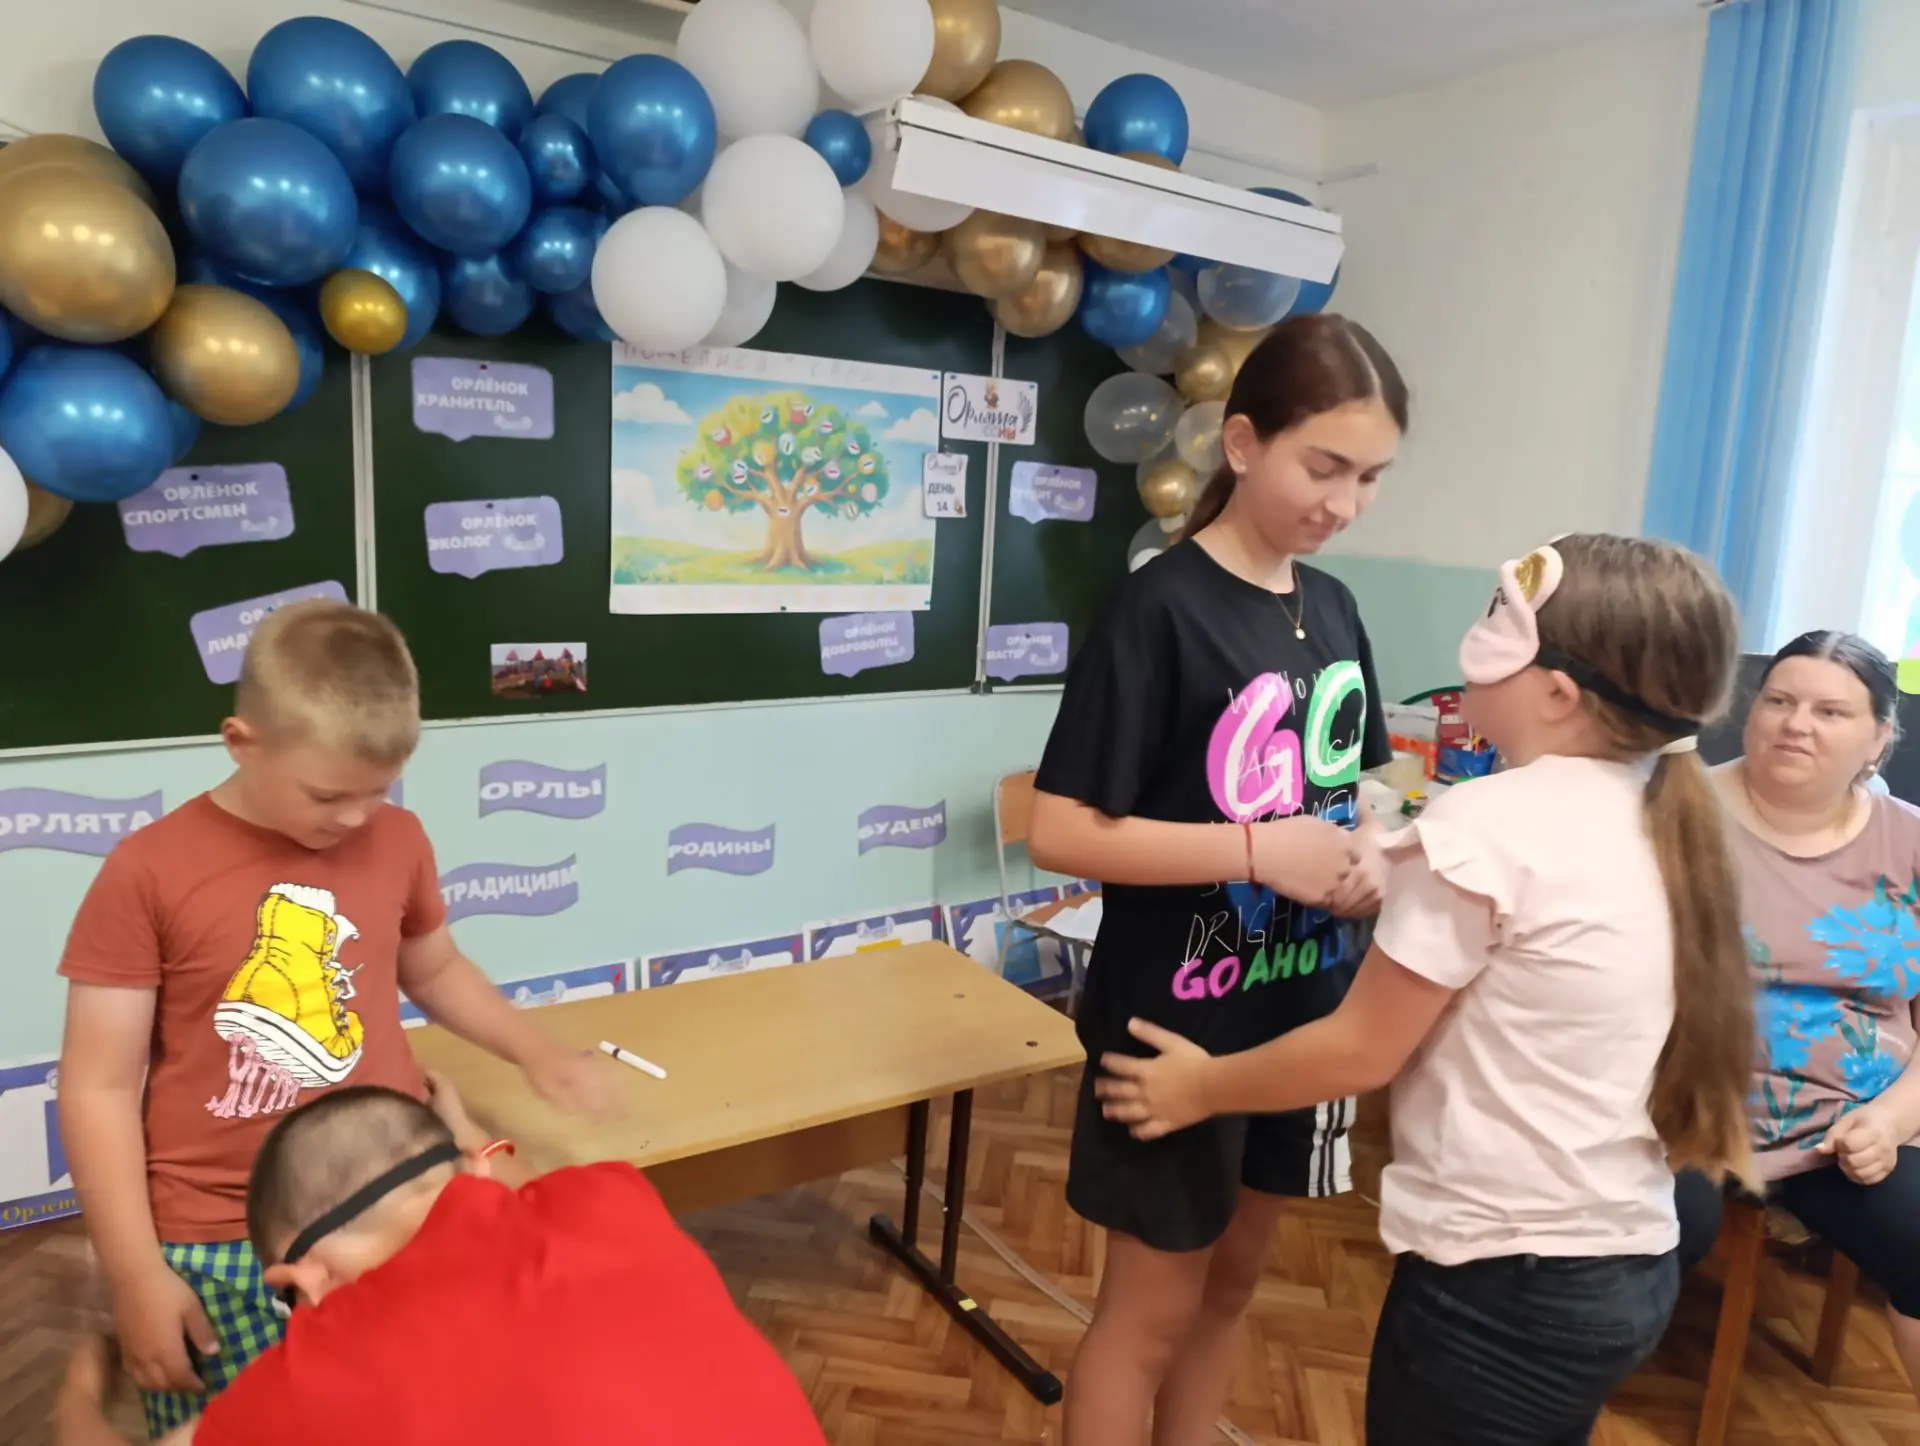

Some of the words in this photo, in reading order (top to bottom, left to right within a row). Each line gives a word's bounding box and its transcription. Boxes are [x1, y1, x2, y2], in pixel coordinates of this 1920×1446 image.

[451, 376, 529, 396] ОРЛЁНОК
[416, 392, 516, 413] ХРАНИТЕЛЬ
[163, 481, 258, 502] ОРЛЁНОК
[927, 482, 956, 495] ДЕНЬ
[123, 502, 247, 526] СПОРТСМЕН
[936, 500, 949, 513] 14
[427, 534, 493, 551] ЭКОЛОГ
[207, 631, 252, 656] ЛИД
[480, 778, 602, 800] ОРЛЫ
[858, 812, 943, 840] БУДЕМ
[668, 838, 771, 859] РОДИНЫ
[440, 863, 578, 907] ТРАДИЦИЯМ
